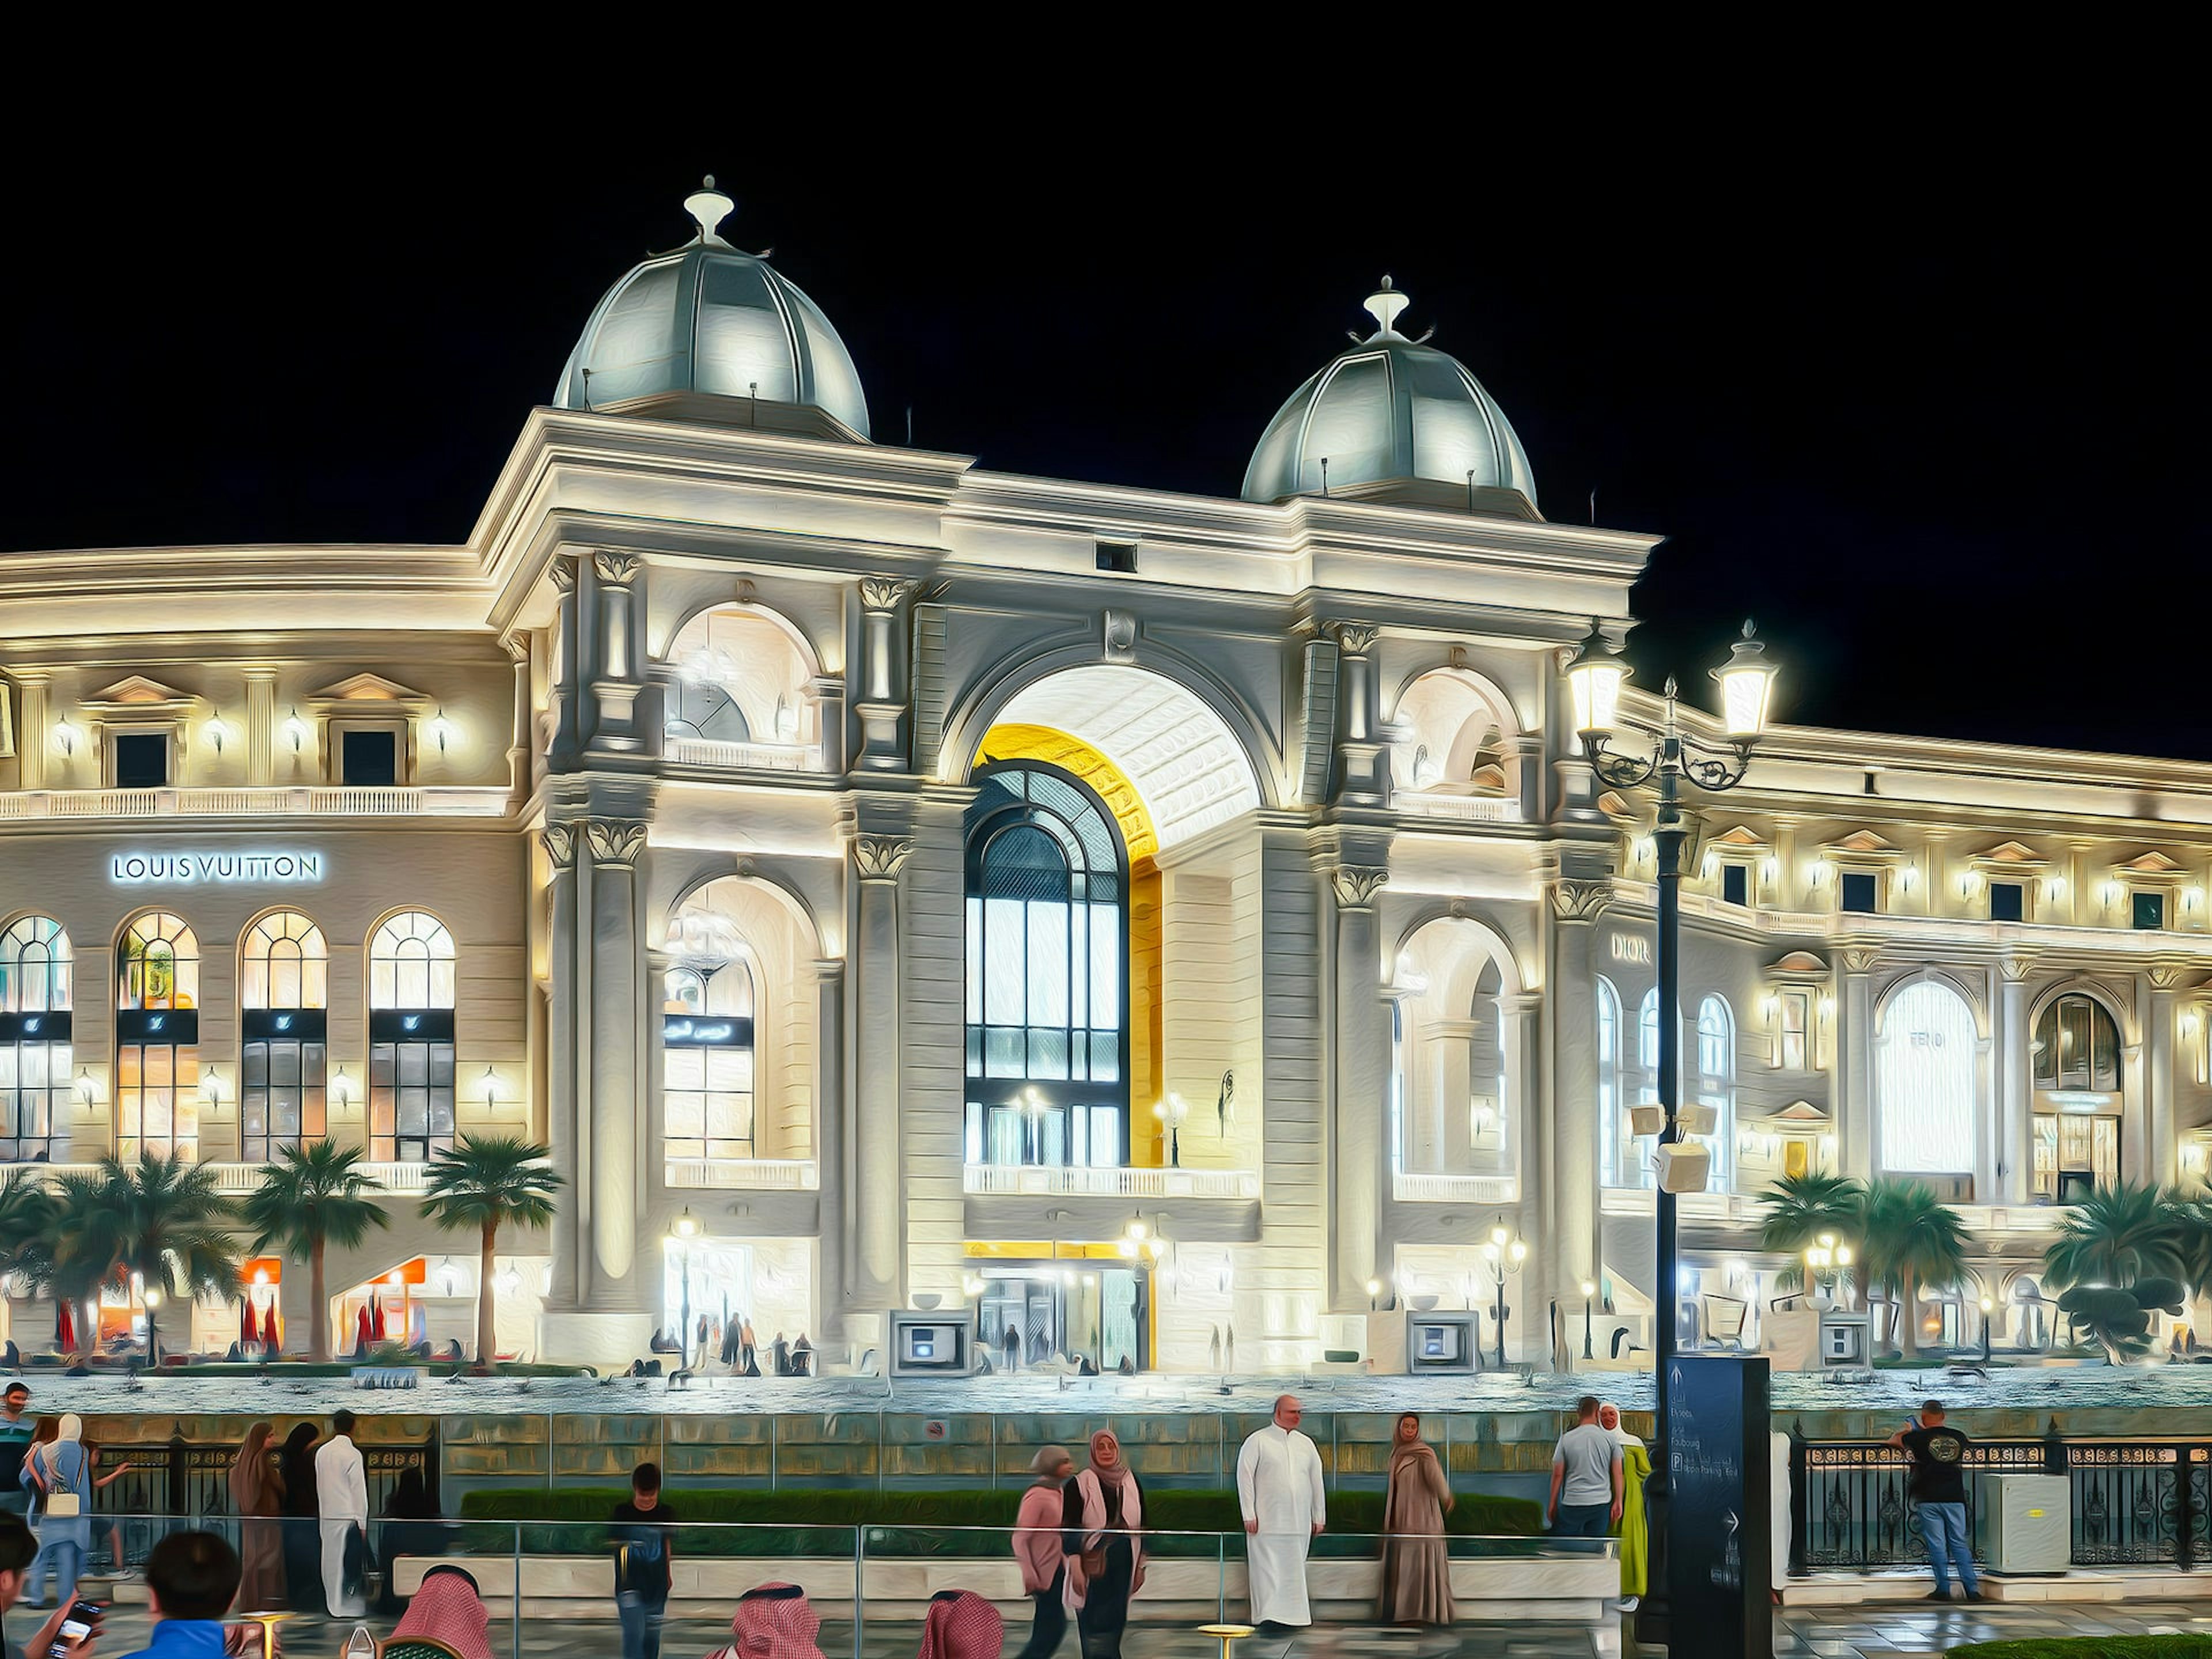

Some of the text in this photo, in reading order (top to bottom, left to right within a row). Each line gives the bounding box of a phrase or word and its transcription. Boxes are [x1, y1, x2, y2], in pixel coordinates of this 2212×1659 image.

[115, 856, 317, 878] LOUIS VUITTON
[1612, 933, 1651, 964] DIOR
